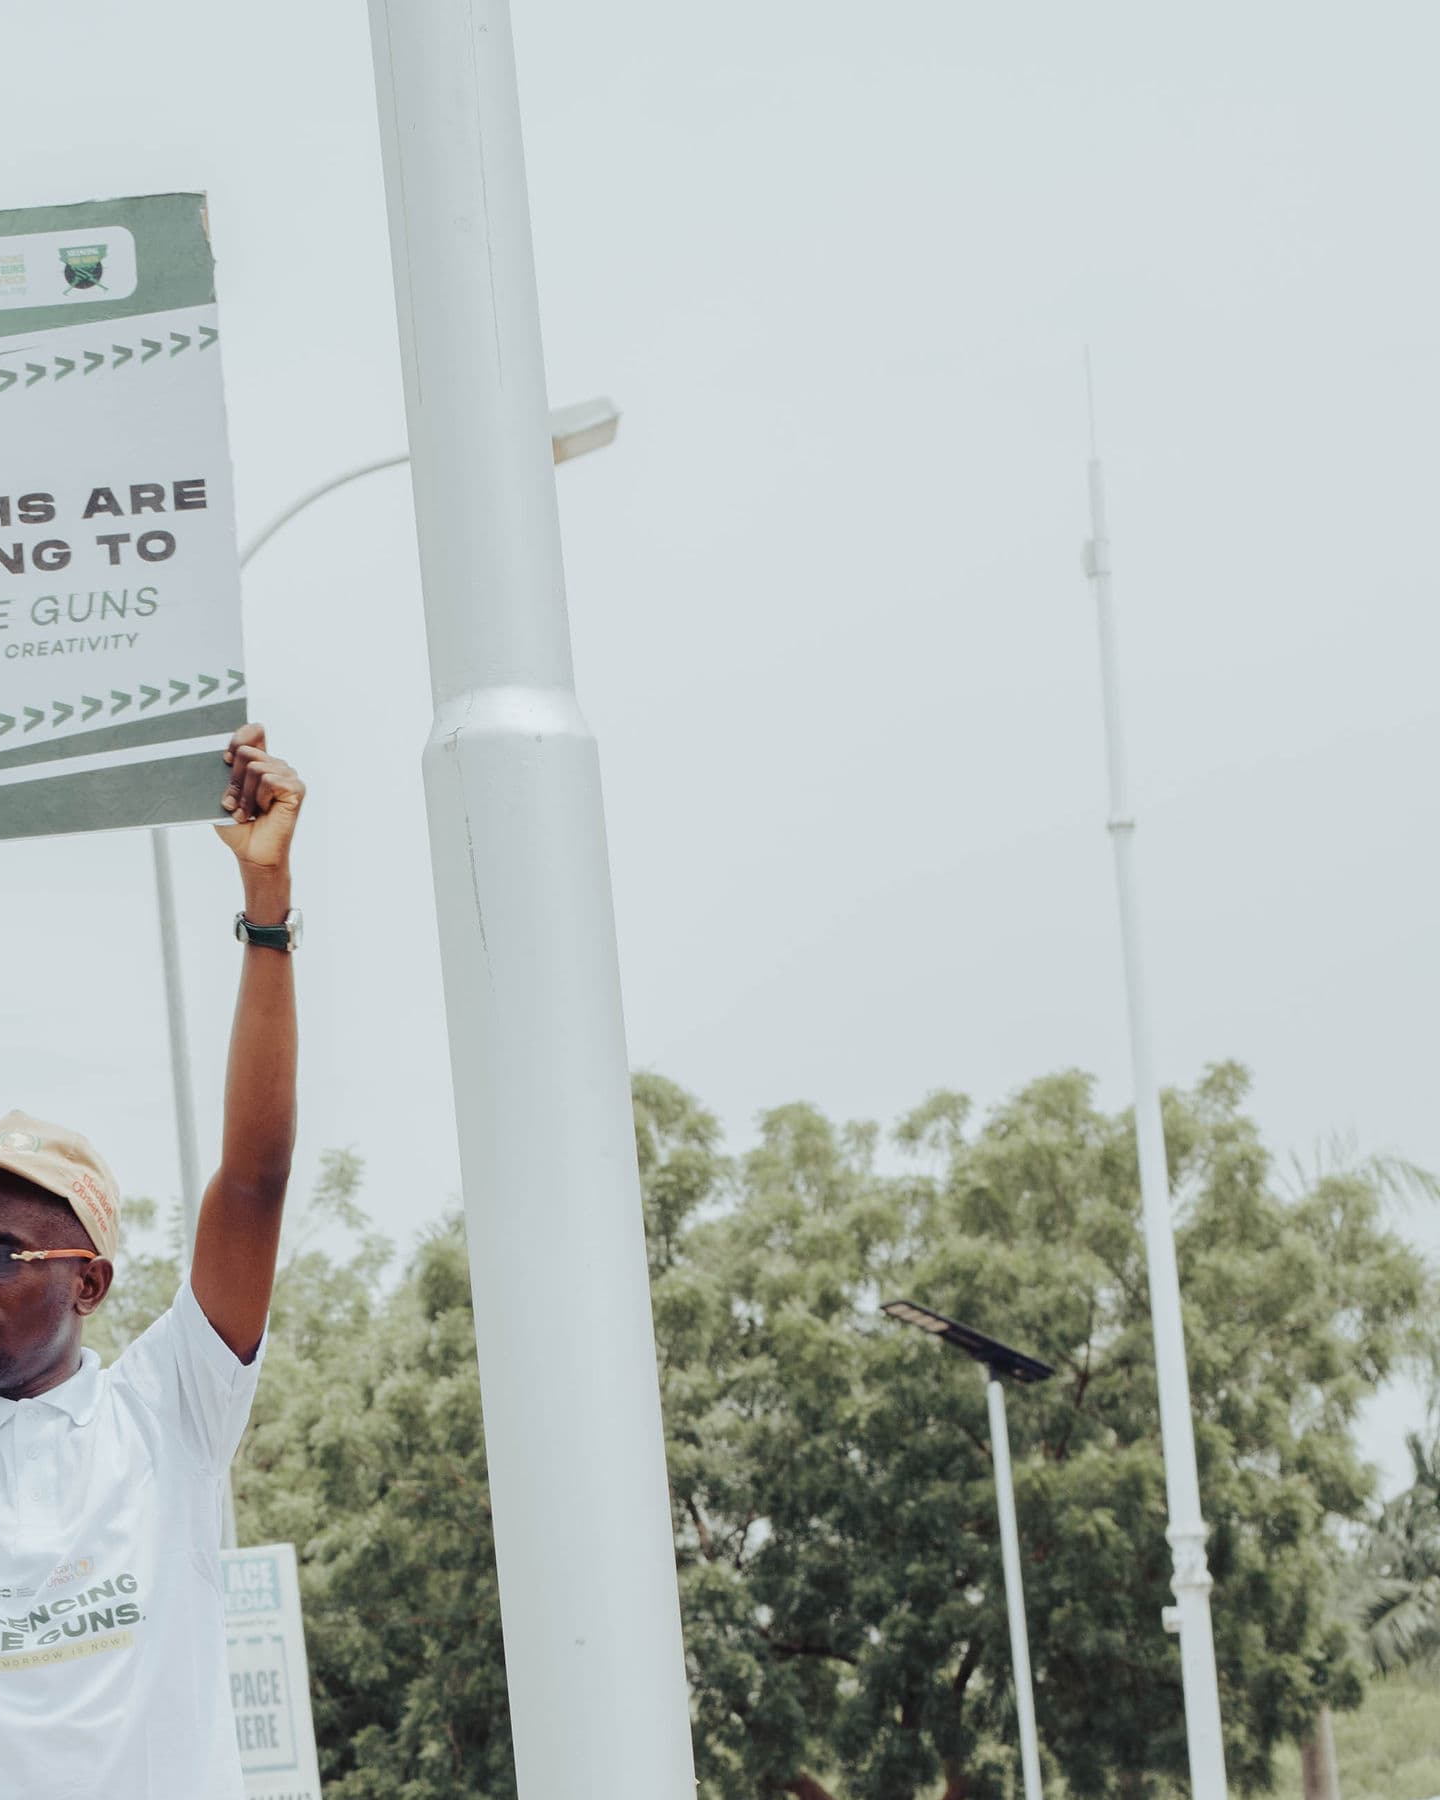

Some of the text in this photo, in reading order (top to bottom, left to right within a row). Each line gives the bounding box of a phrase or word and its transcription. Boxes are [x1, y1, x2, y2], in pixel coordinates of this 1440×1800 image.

[81, 478, 208, 519] ARE
[95, 530, 177, 566] TO
[30, 586, 159, 626] GUNS
[5, 632, 139, 662] CREATIVITY
[229, 1670, 282, 1709] PACE
